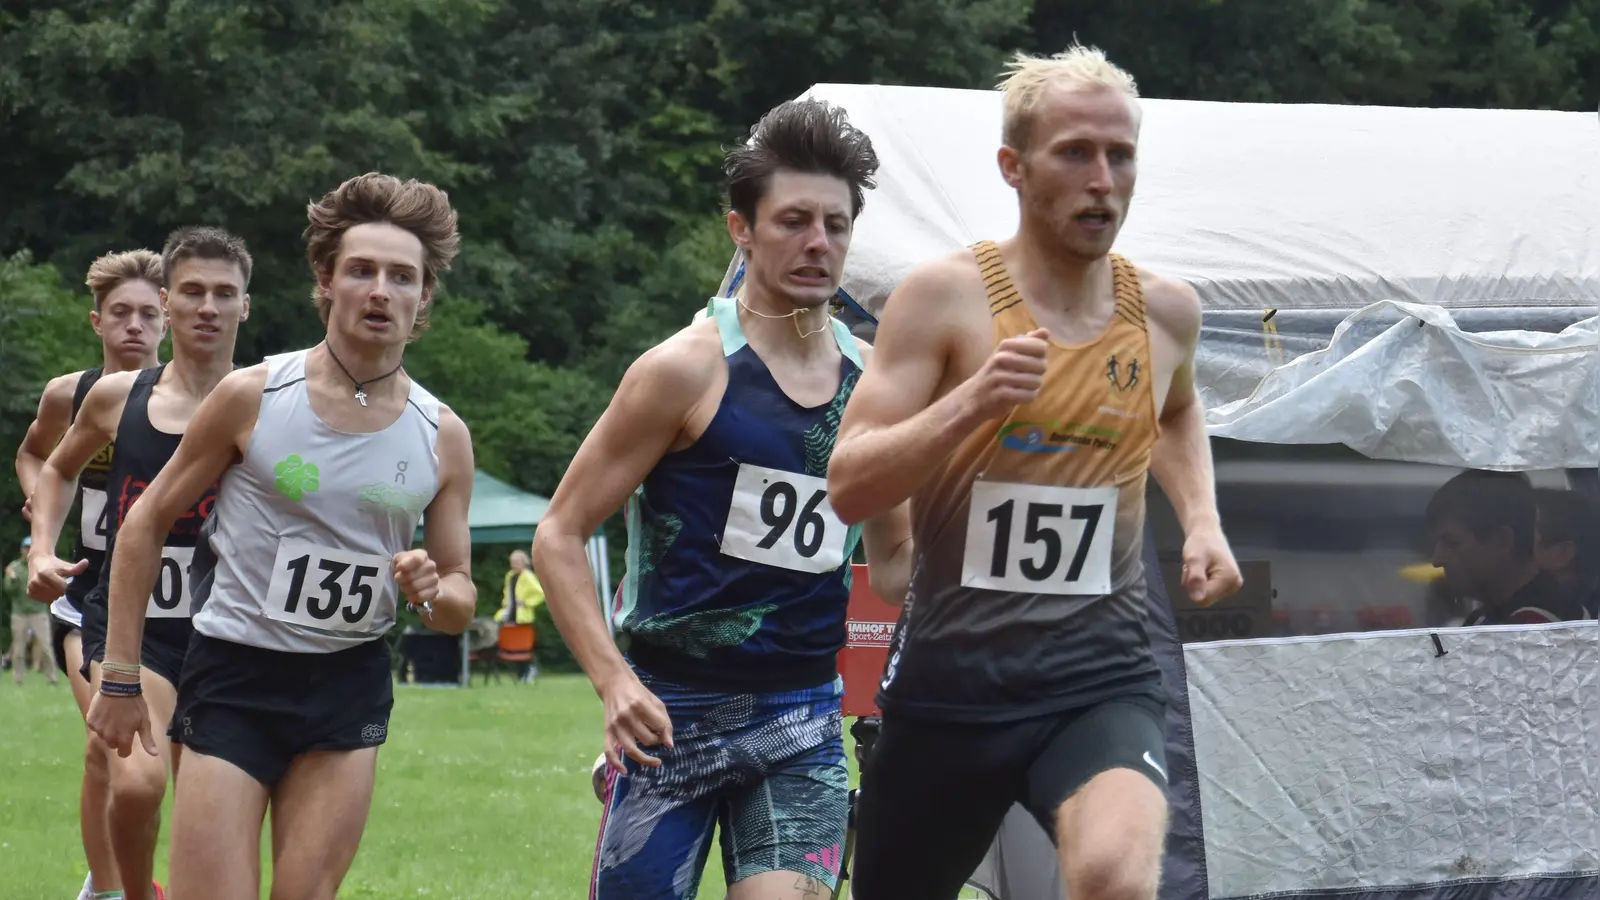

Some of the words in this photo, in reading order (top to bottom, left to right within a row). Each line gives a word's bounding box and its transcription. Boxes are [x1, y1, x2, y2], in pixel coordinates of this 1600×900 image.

[755, 480, 828, 558] 96
[986, 498, 1105, 582] 157
[283, 552, 379, 623] 135
[848, 623, 885, 633] IMHOF
